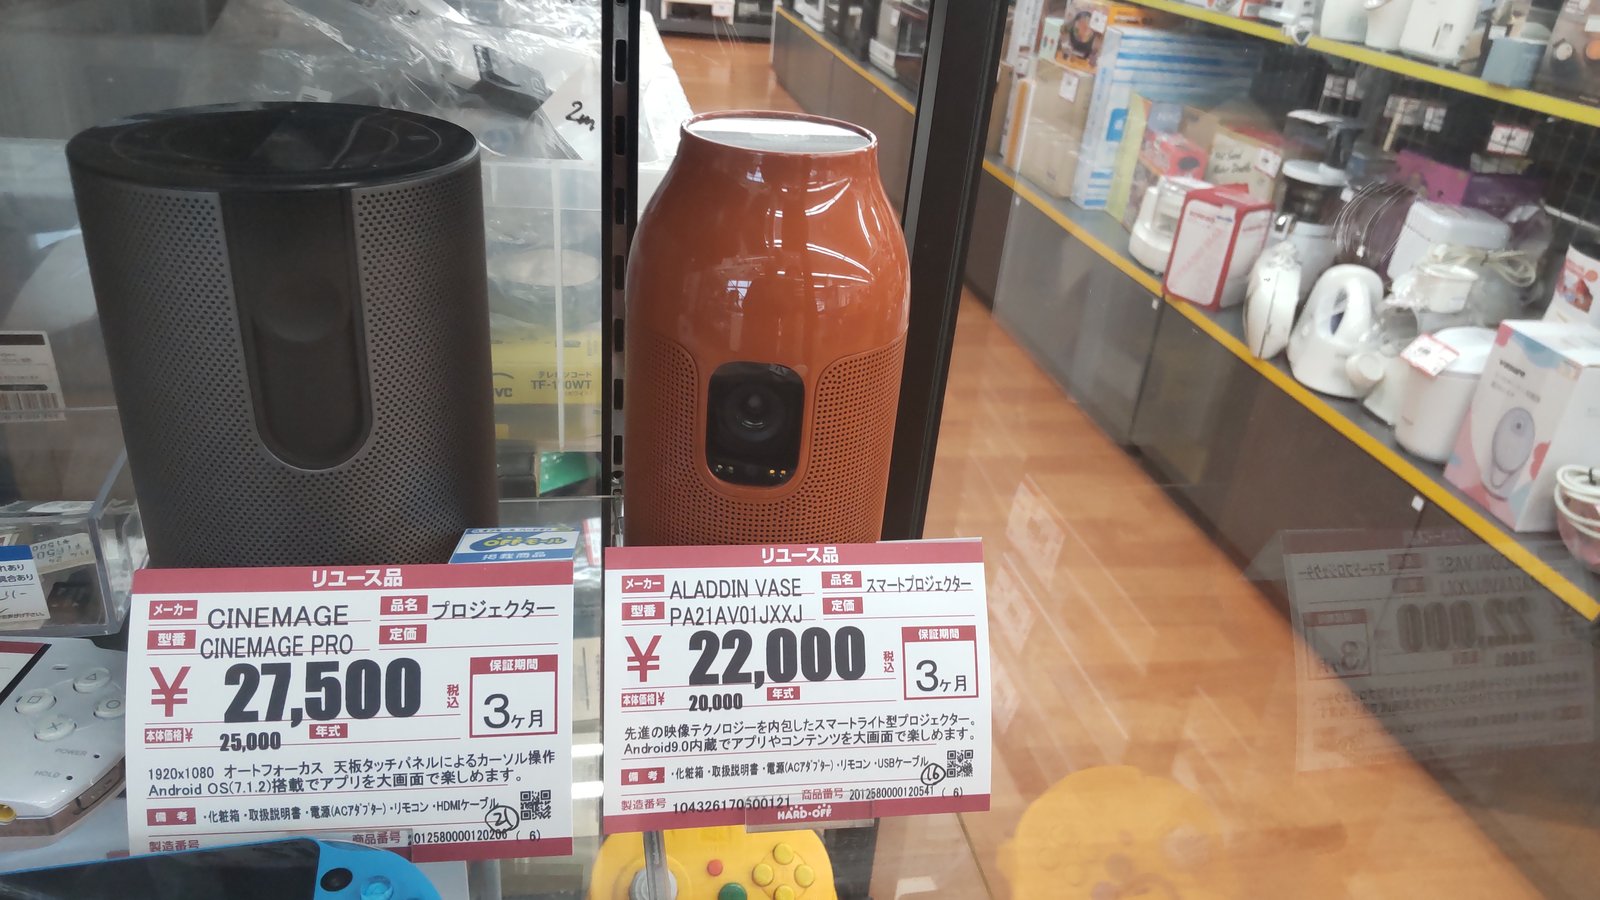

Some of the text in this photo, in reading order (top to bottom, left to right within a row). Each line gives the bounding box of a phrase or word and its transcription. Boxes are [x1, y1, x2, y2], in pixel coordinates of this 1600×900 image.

[530, 380, 592, 390] TF-10WT
[762, 547, 839, 564] リユース品
[312, 568, 402, 588] リユース品
[625, 578, 661, 590] メーカー
[830, 573, 854, 586] 品名
[866, 575, 972, 593] スマートプロジェクター
[670, 578, 802, 600] ALADDIN VASE
[153, 602, 194, 617] メーカー
[390, 598, 418, 612] 品名
[432, 599, 556, 621] プロジェクター
[631, 605, 656, 617] 型番
[831, 599, 855, 612] 定価
[207, 605, 349, 630] CINEMAGE
[670, 605, 803, 626] PA21AV01JXXJ
[157, 632, 186, 647] 型番
[389, 627, 417, 642] 定価
[918, 628, 960, 641] 保証期間
[200, 634, 354, 660] CINEMAGE PRO
[489, 658, 538, 671] 保証期間
[688, 625, 866, 689] 22,000
[883, 651, 894, 673] 税込
[224, 658, 421, 728] 27,500
[446, 684, 459, 709] 税込
[772, 688, 795, 699] 年式
[688, 693, 743, 712] 20,000
[316, 725, 341, 738] 年式
[219, 731, 281, 753] 25,000
[34, 770, 61, 779] HOLD
[148, 766, 214, 781] 1920x1080
[224, 761, 324, 779] オートフォーカス
[148, 782, 202, 797] Android
[802, 787, 843, 800] 商品番号
[621, 798, 666, 811] 製造番号
[352, 831, 401, 845] 商品番号
